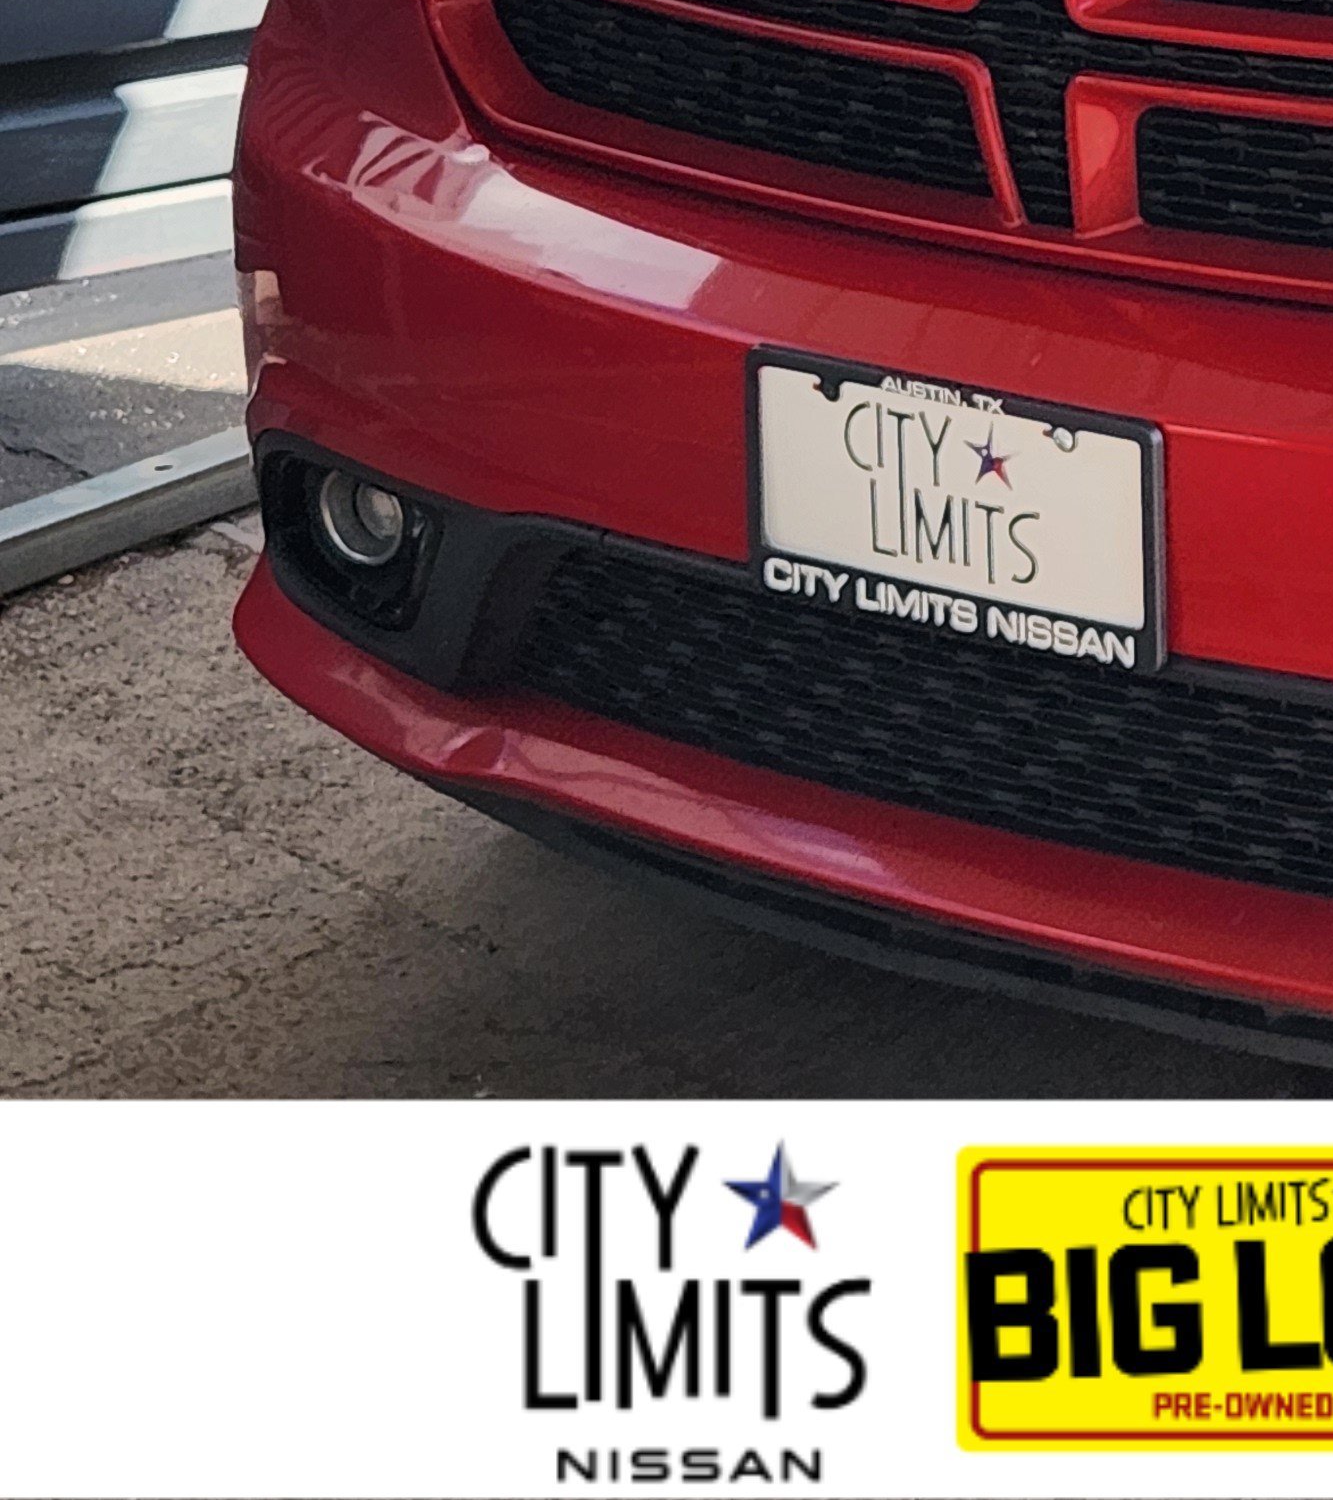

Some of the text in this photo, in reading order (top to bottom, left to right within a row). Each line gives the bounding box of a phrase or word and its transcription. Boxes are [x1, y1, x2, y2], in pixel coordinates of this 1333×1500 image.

[844, 401, 951, 490] CITY
[972, 393, 1006, 415] TX
[869, 478, 1040, 585] LIMITS
[763, 557, 1135, 669] CITY LIMITS NISSAN
